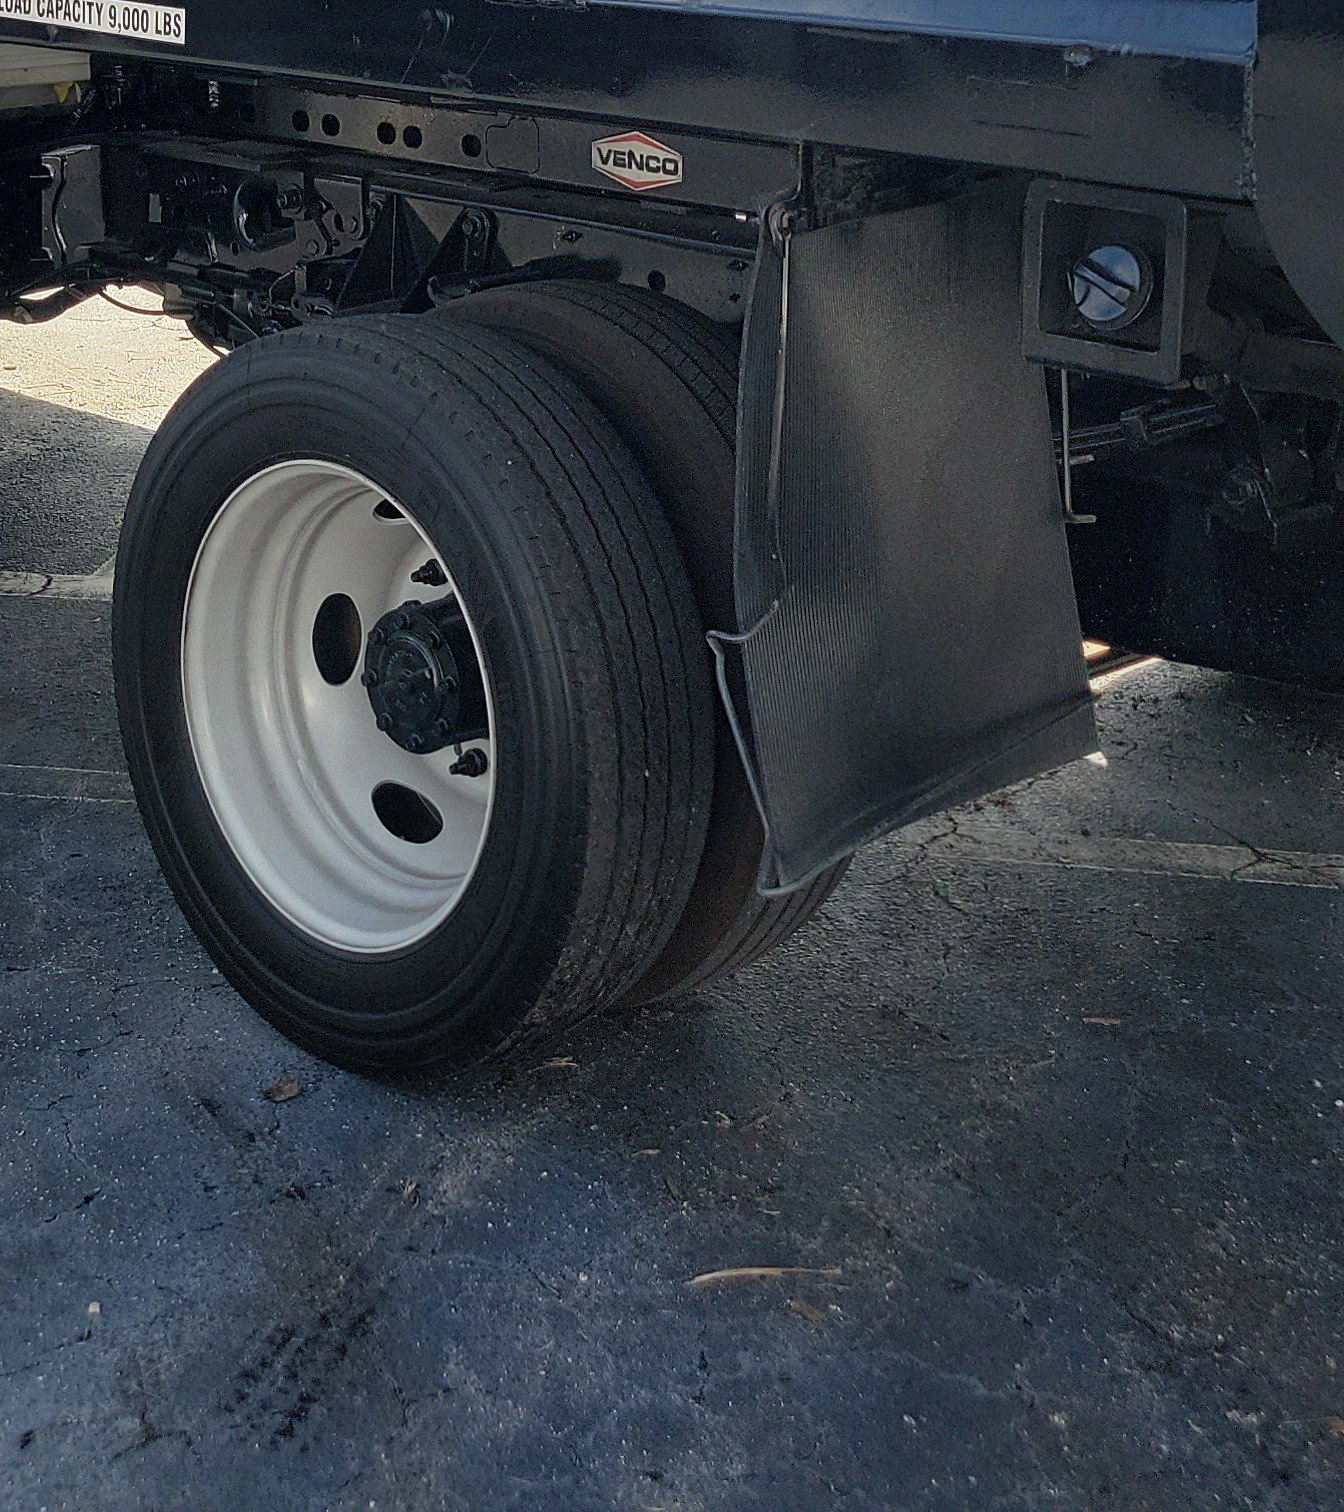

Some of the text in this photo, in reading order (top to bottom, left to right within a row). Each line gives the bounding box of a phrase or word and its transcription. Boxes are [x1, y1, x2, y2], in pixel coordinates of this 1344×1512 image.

[109, 4, 150, 34] 9,000
[156, 11, 181, 39] LBS
[596, 146, 679, 177] VENCO
